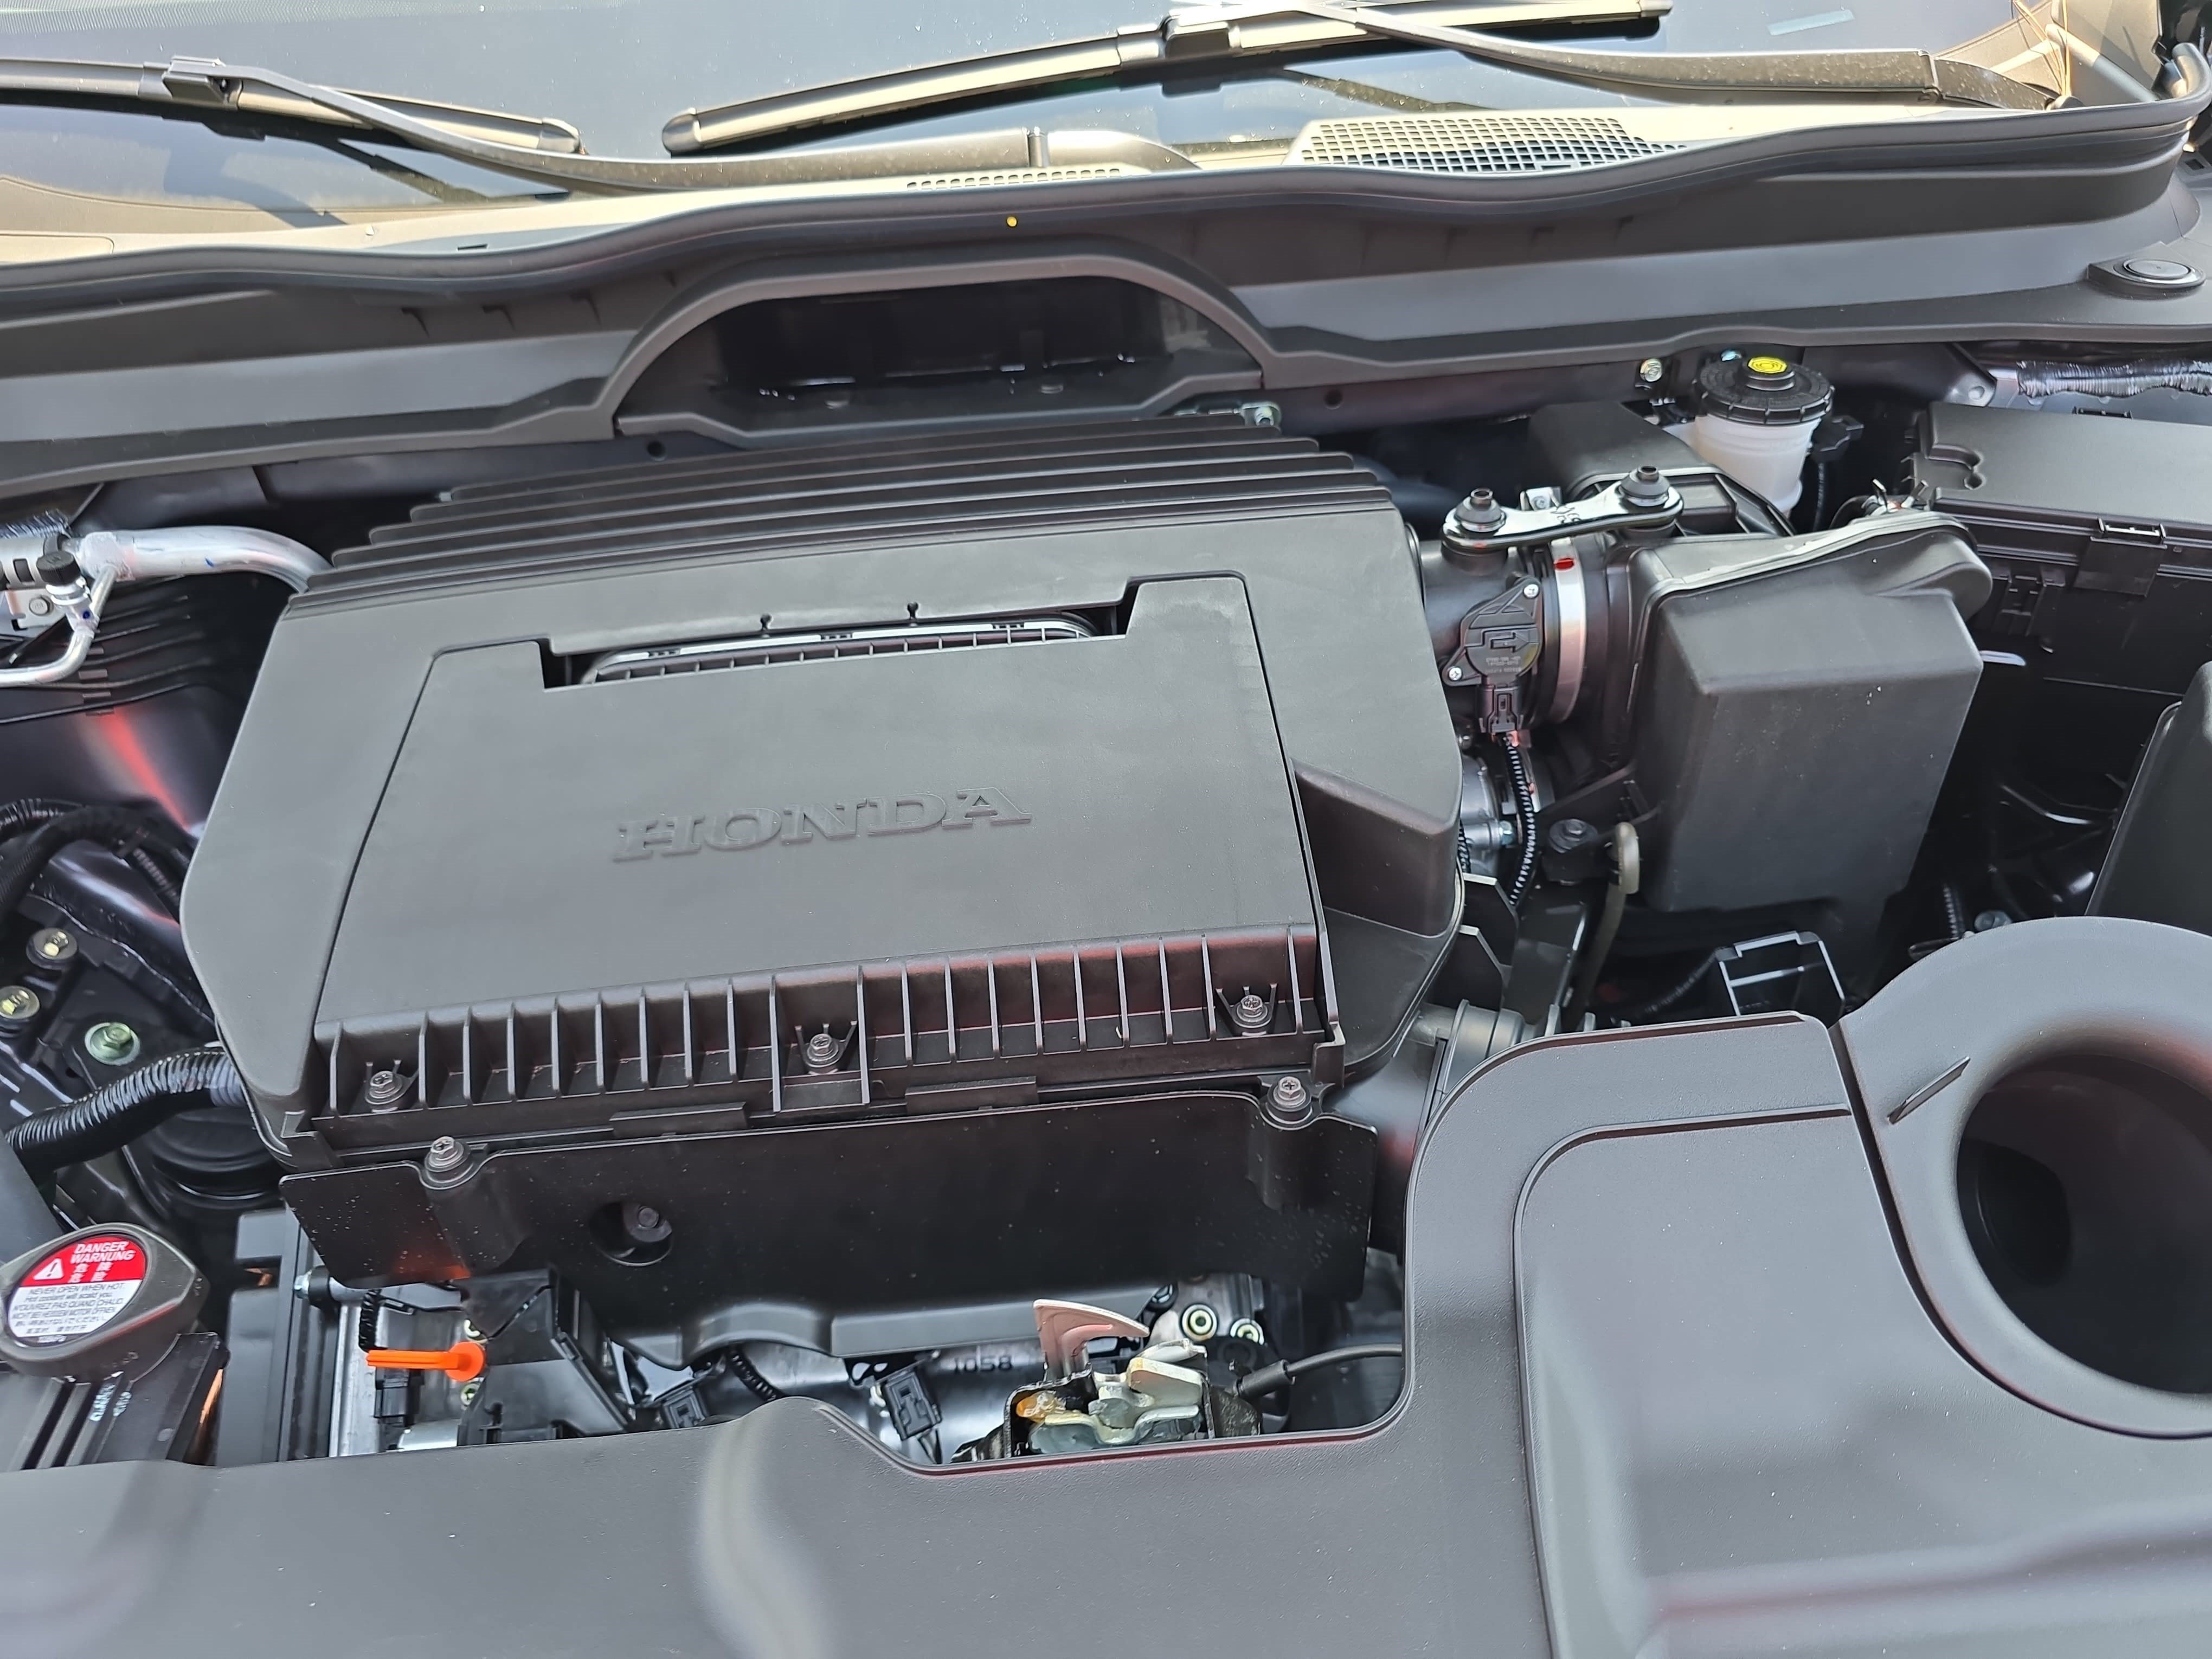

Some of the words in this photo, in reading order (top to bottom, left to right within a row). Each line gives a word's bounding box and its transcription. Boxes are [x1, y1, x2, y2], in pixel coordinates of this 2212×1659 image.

[613, 787, 1032, 863] HONDA
[73, 1241, 128, 1253] DANGER
[70, 1250, 136, 1264] WARNUNG
